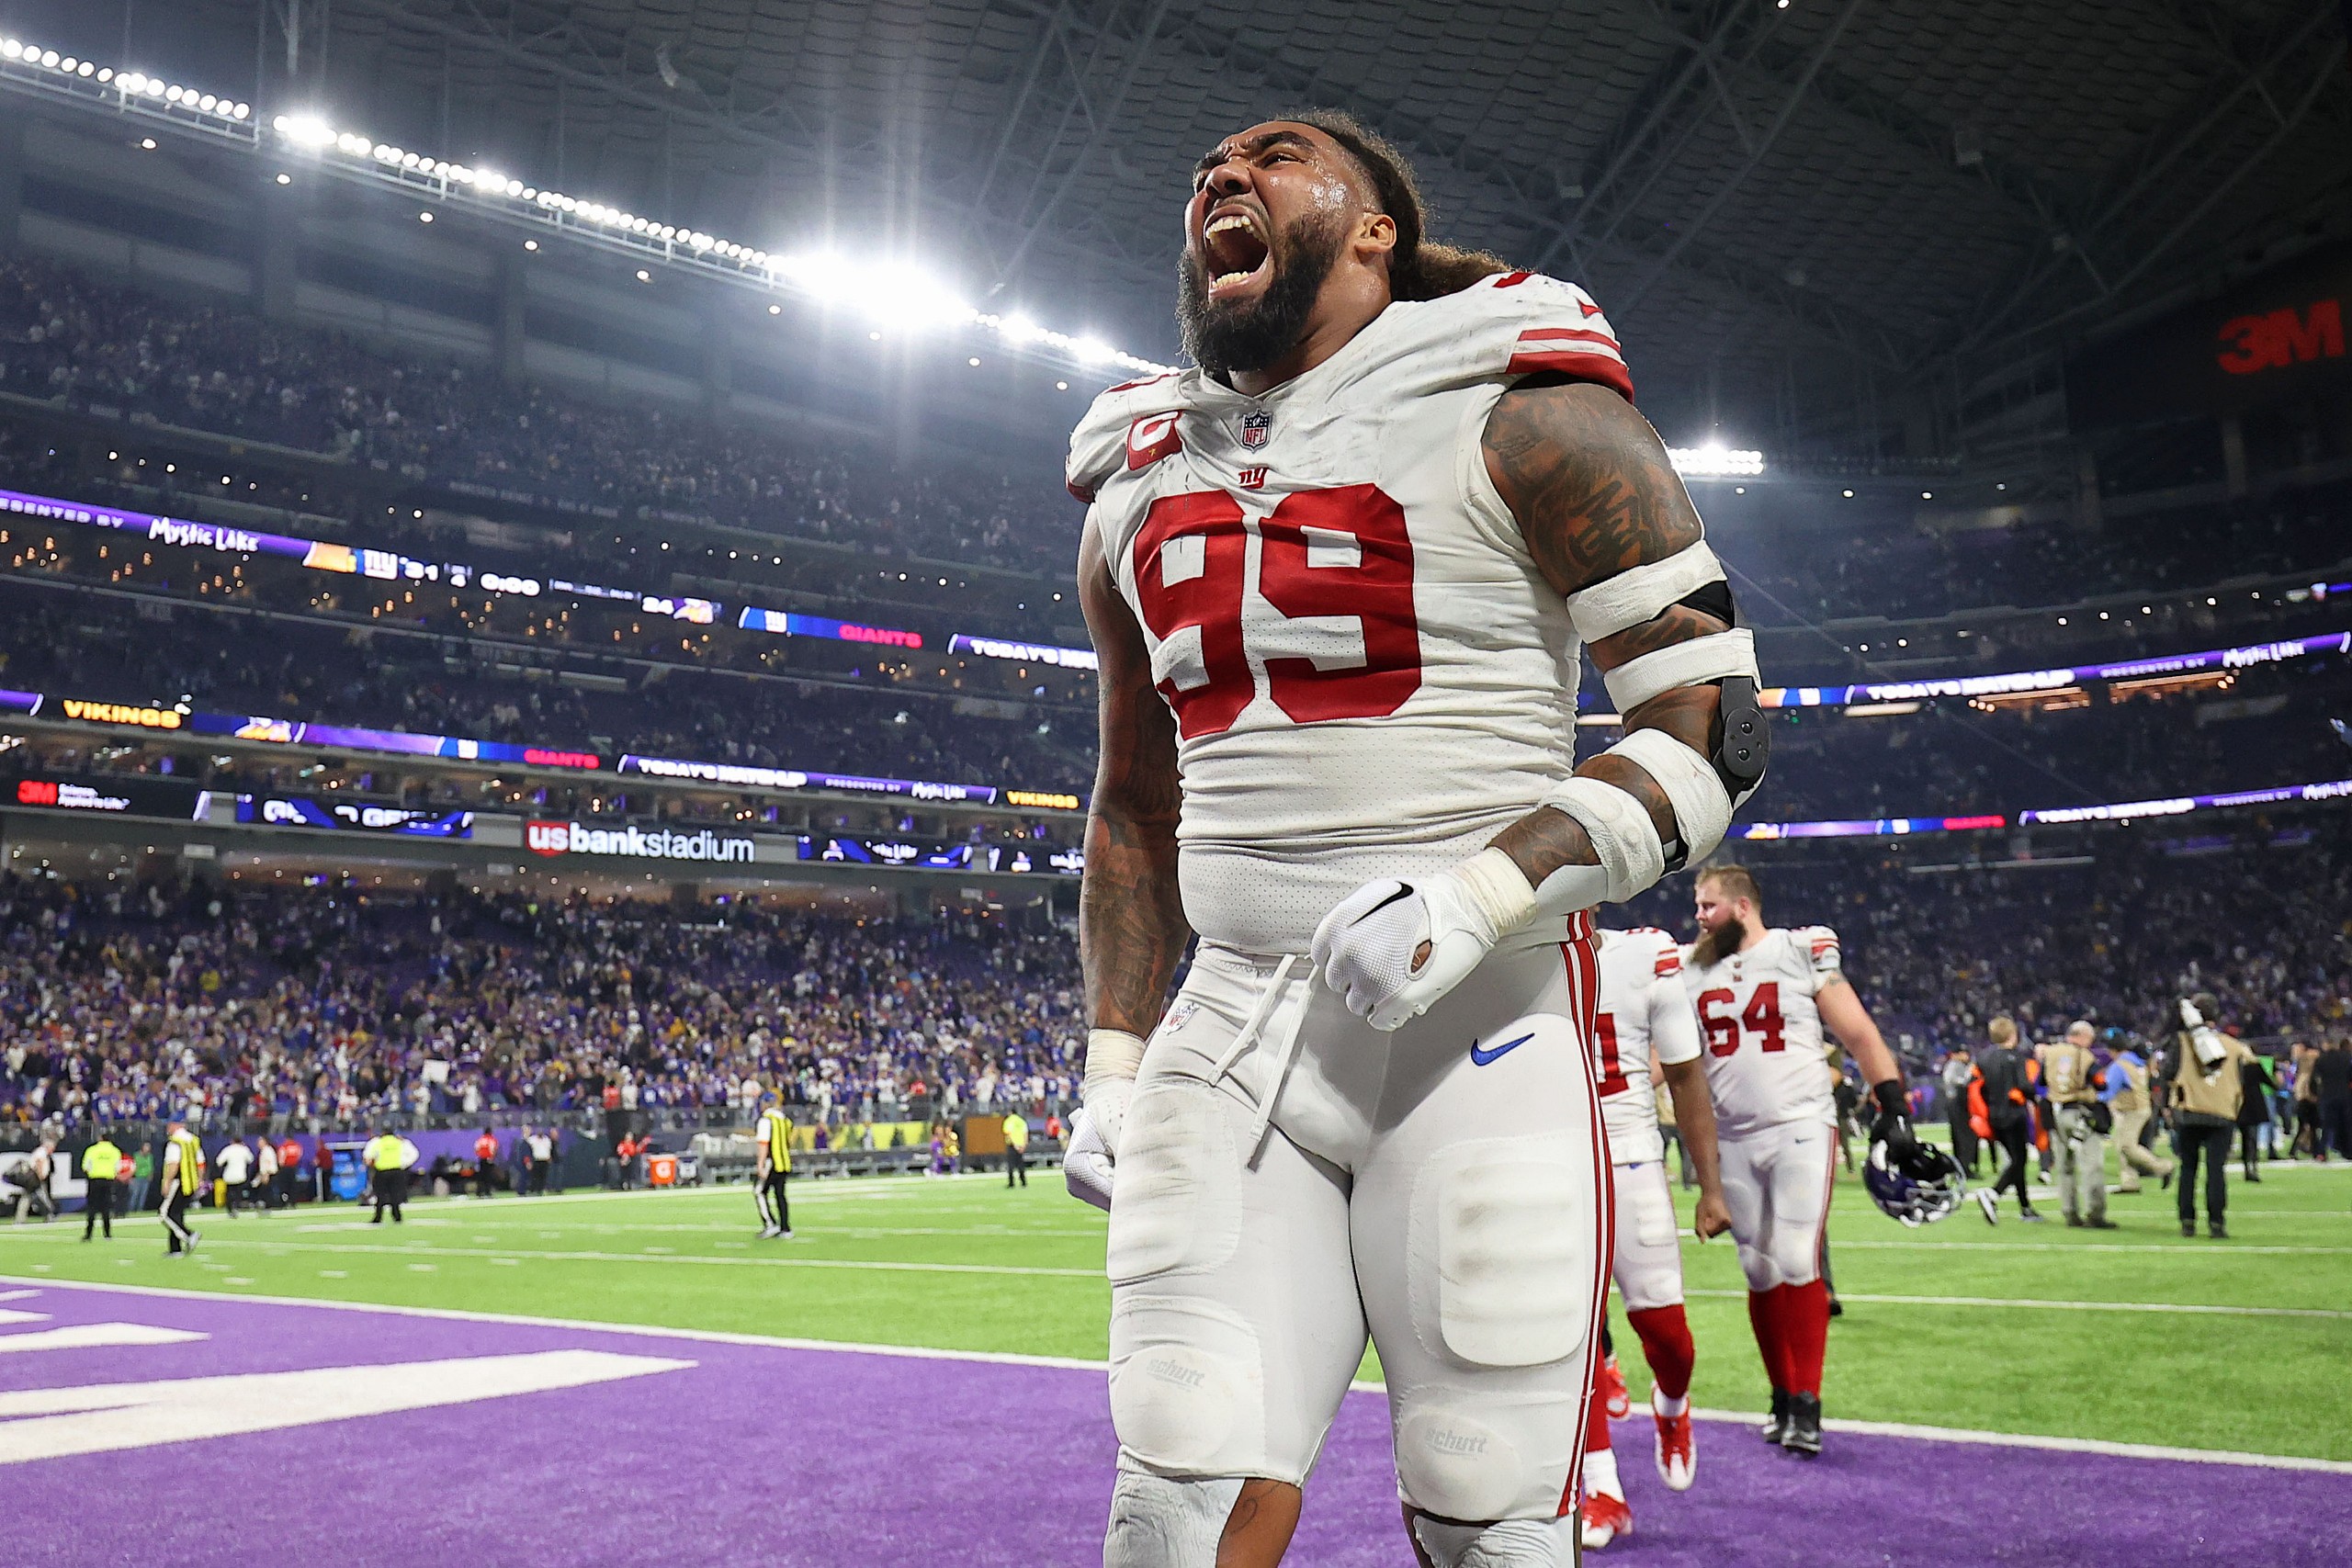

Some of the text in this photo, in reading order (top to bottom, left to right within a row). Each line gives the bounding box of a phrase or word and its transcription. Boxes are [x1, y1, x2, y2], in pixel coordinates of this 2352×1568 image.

[2218, 299, 2346, 374] 3M
[1244, 427, 1266, 446] NFL
[480, 572, 541, 597] 0:00
[641, 596, 675, 615] 24
[1134, 482, 1422, 740] 99
[839, 624, 922, 649] GIANTS
[969, 637, 1058, 666] TODAY'S
[62, 699, 182, 730] VIKINGS
[524, 748, 600, 770] GIANTS
[17, 780, 58, 806] 3M
[1007, 790, 1080, 810] VIKINGS
[1697, 981, 1786, 1058] 64
